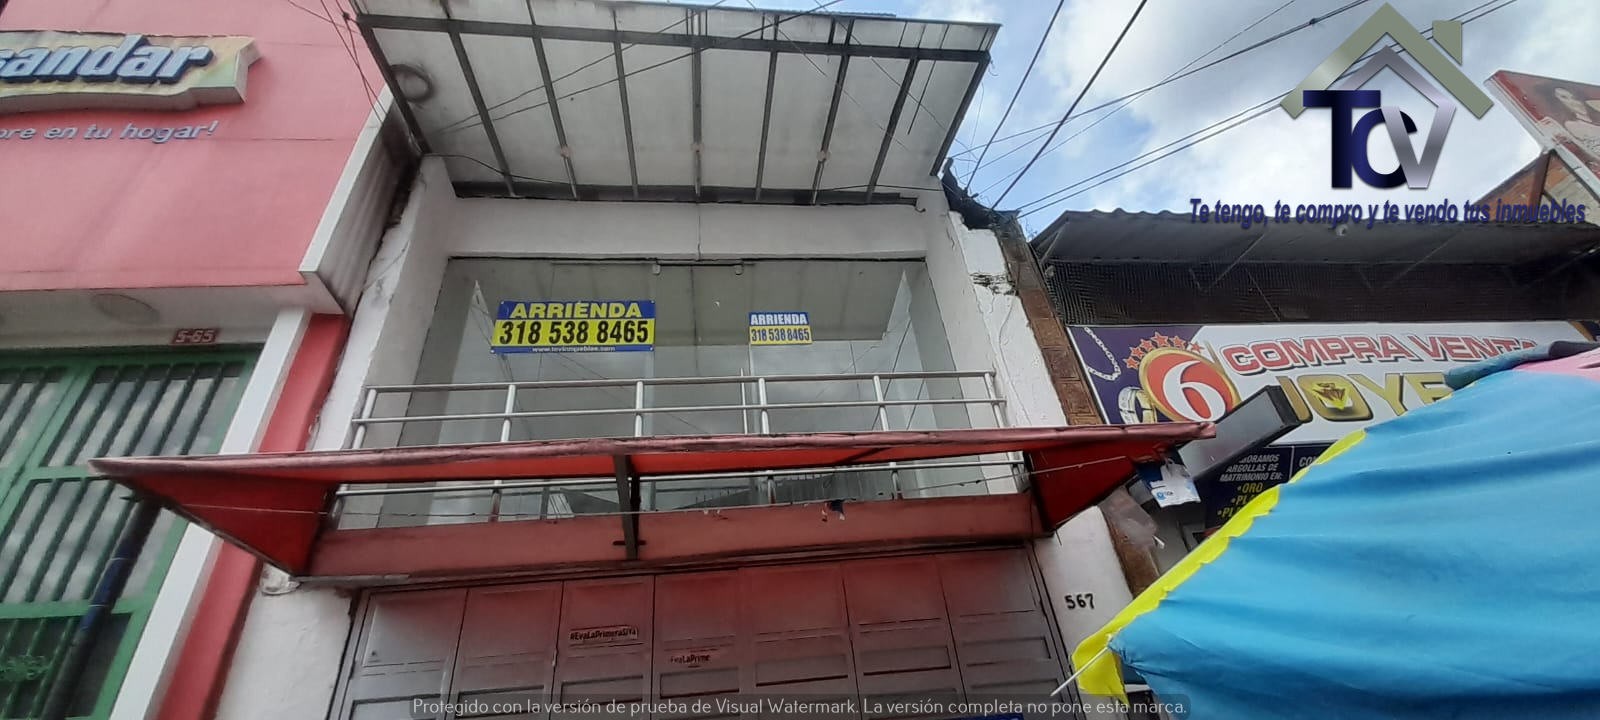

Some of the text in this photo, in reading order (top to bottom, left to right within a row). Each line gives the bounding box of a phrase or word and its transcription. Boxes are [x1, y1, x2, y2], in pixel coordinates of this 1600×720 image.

[43, 126, 78, 141] en
[83, 122, 113, 141] tu
[119, 120, 218, 144] hogar!
[509, 302, 643, 319] ARRIENDA
[750, 313, 808, 325] ARRIENDA
[500, 320, 649, 345] 318 538 8465
[751, 328, 810, 341] 318 538 8465
[1220, 336, 1420, 374] COMPRA
[1162, 359, 1228, 422] 6
[1226, 463, 1280, 473] ARGOLLAS DE
[1219, 472, 1268, 482] MATRIMONIO
[1064, 593, 1096, 610] 567
